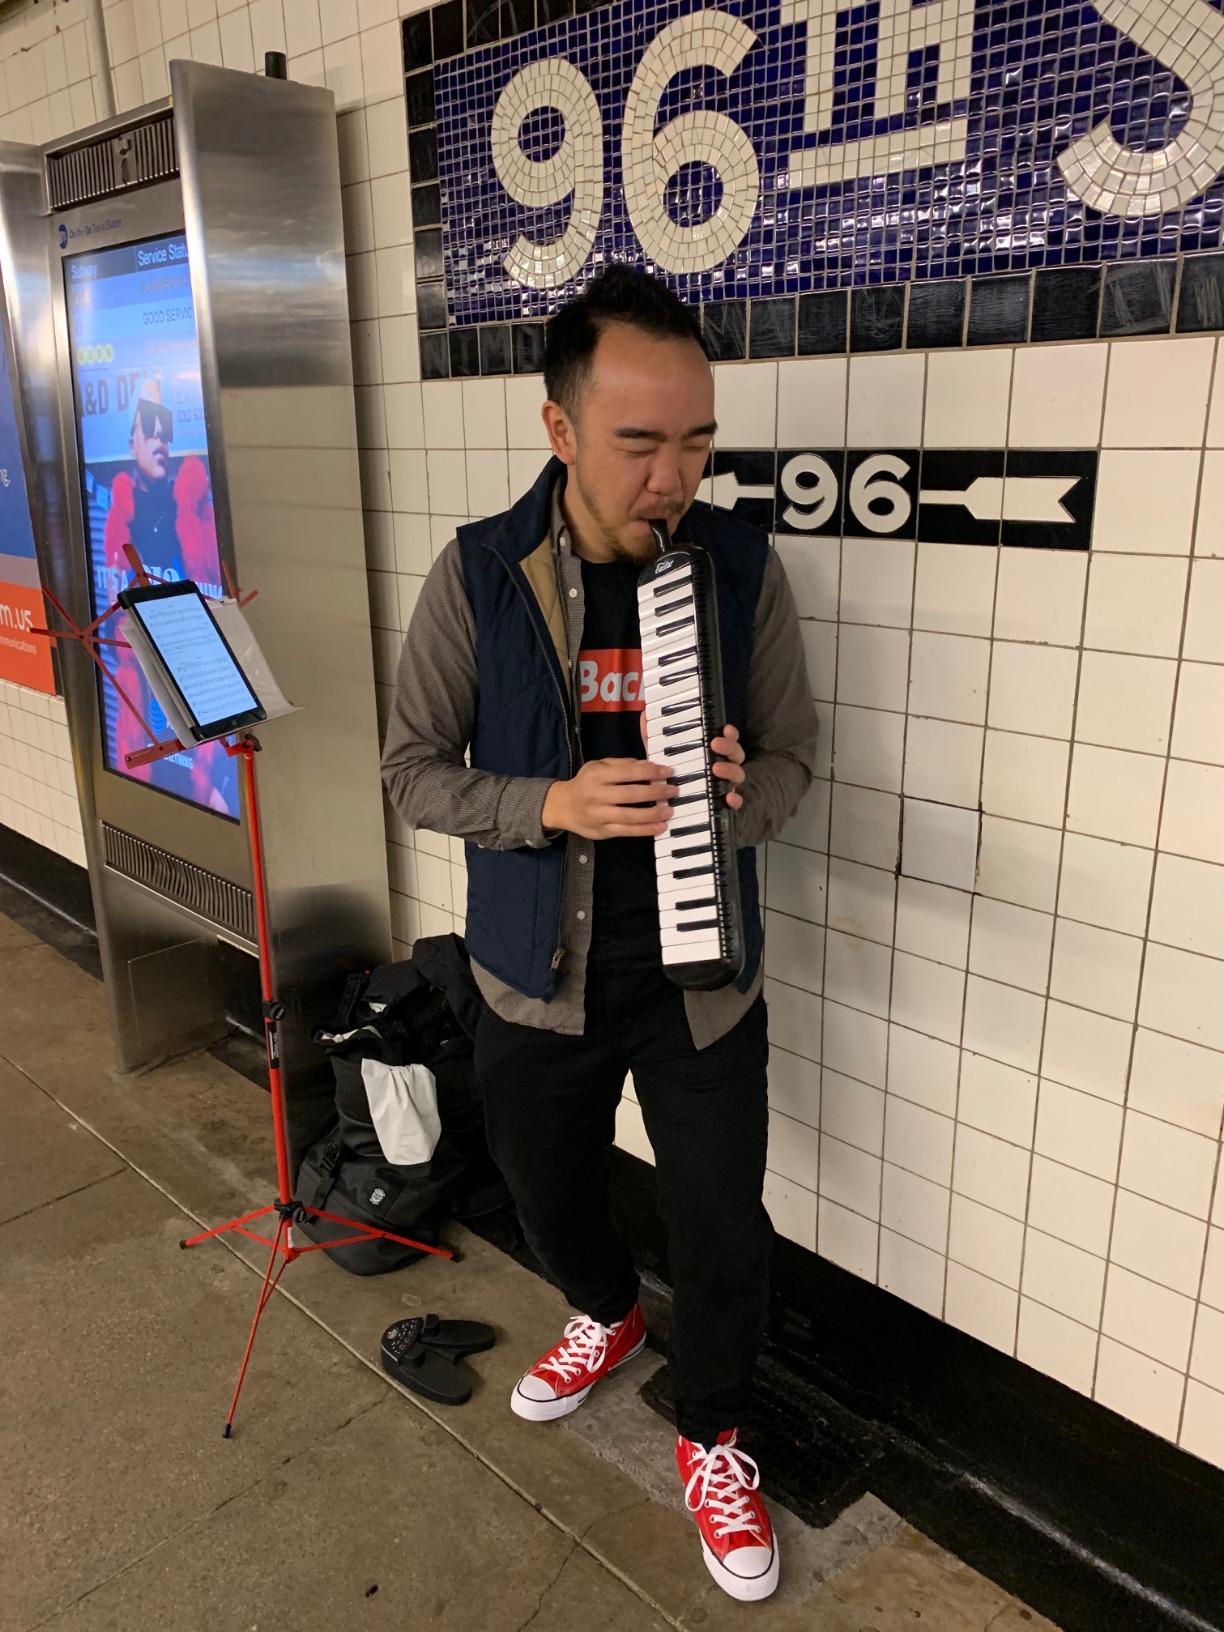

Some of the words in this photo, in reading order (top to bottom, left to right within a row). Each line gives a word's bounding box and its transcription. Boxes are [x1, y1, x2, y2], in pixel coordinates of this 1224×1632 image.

[491, 0, 977, 289] 96TH
[138, 248, 167, 266] Service
[168, 243, 188, 259] Stat
[781, 452, 912, 534] 96
